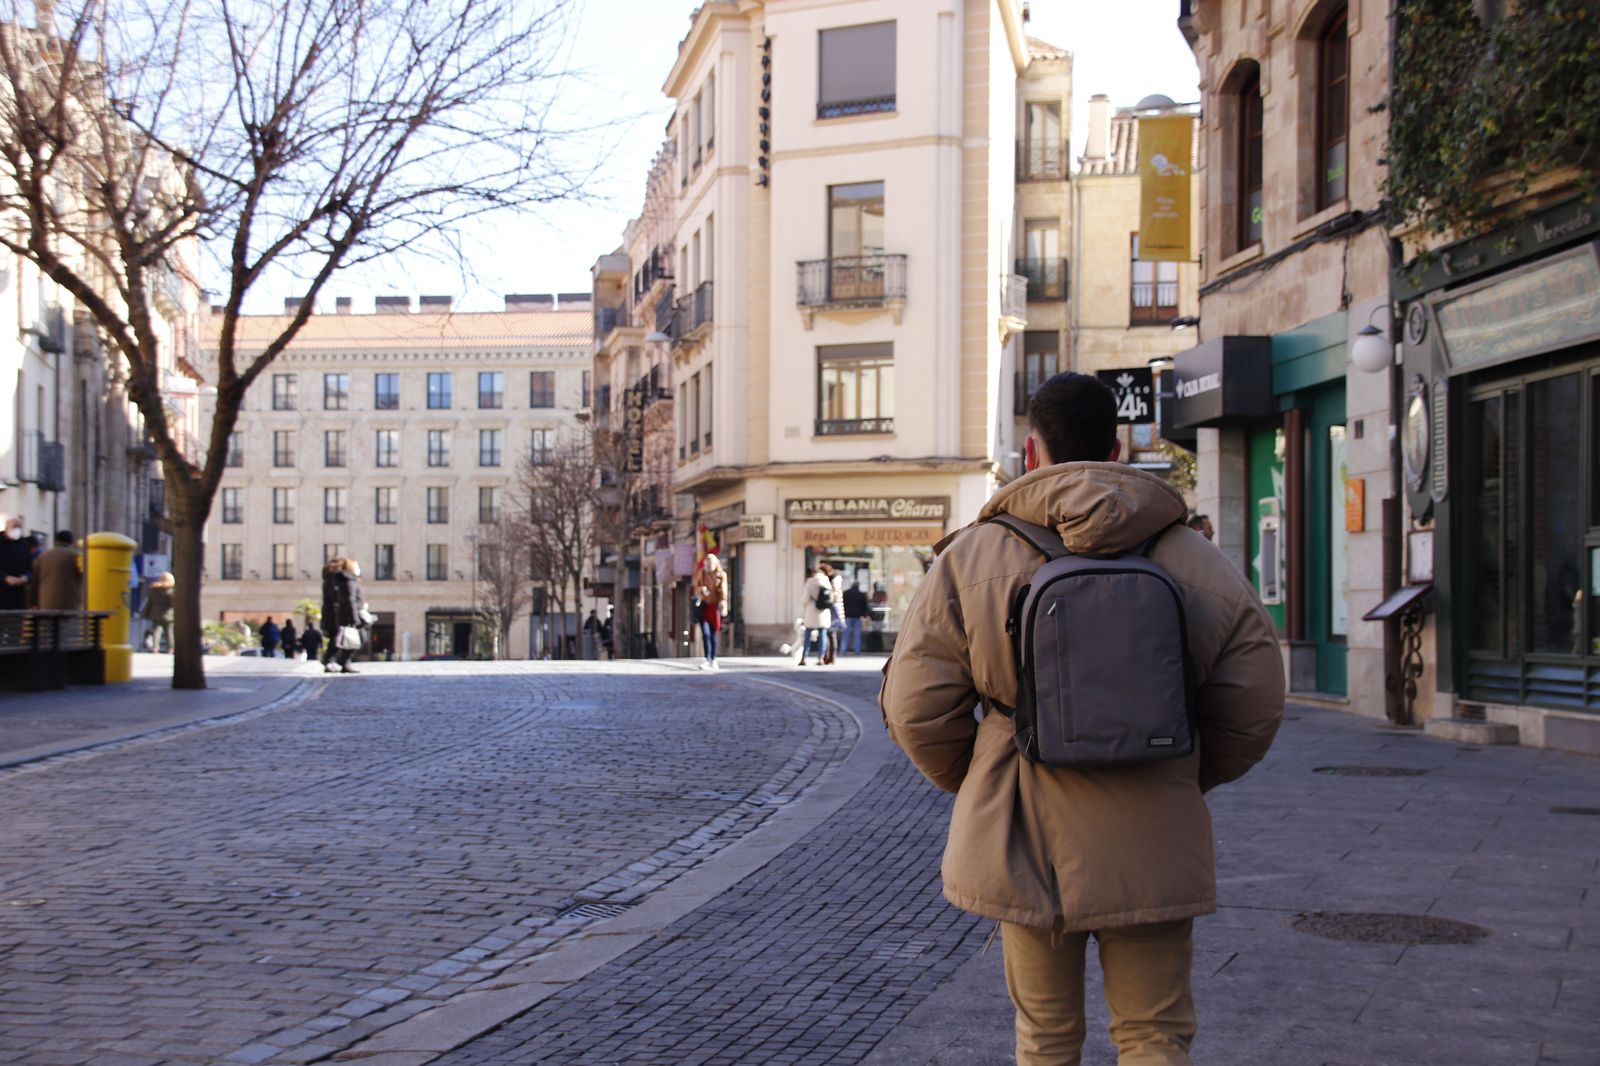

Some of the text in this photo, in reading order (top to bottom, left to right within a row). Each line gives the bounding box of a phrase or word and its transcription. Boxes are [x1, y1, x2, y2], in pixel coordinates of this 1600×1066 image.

[1533, 207, 1591, 242] Mercado
[1111, 385, 1150, 395] JERO
[627, 391, 641, 472] HOTEL
[790, 499, 944, 517] ARTESANIA Charra
[741, 525, 765, 538] TRAGO
[804, 529, 929, 543] Regalos BUITRAGO
